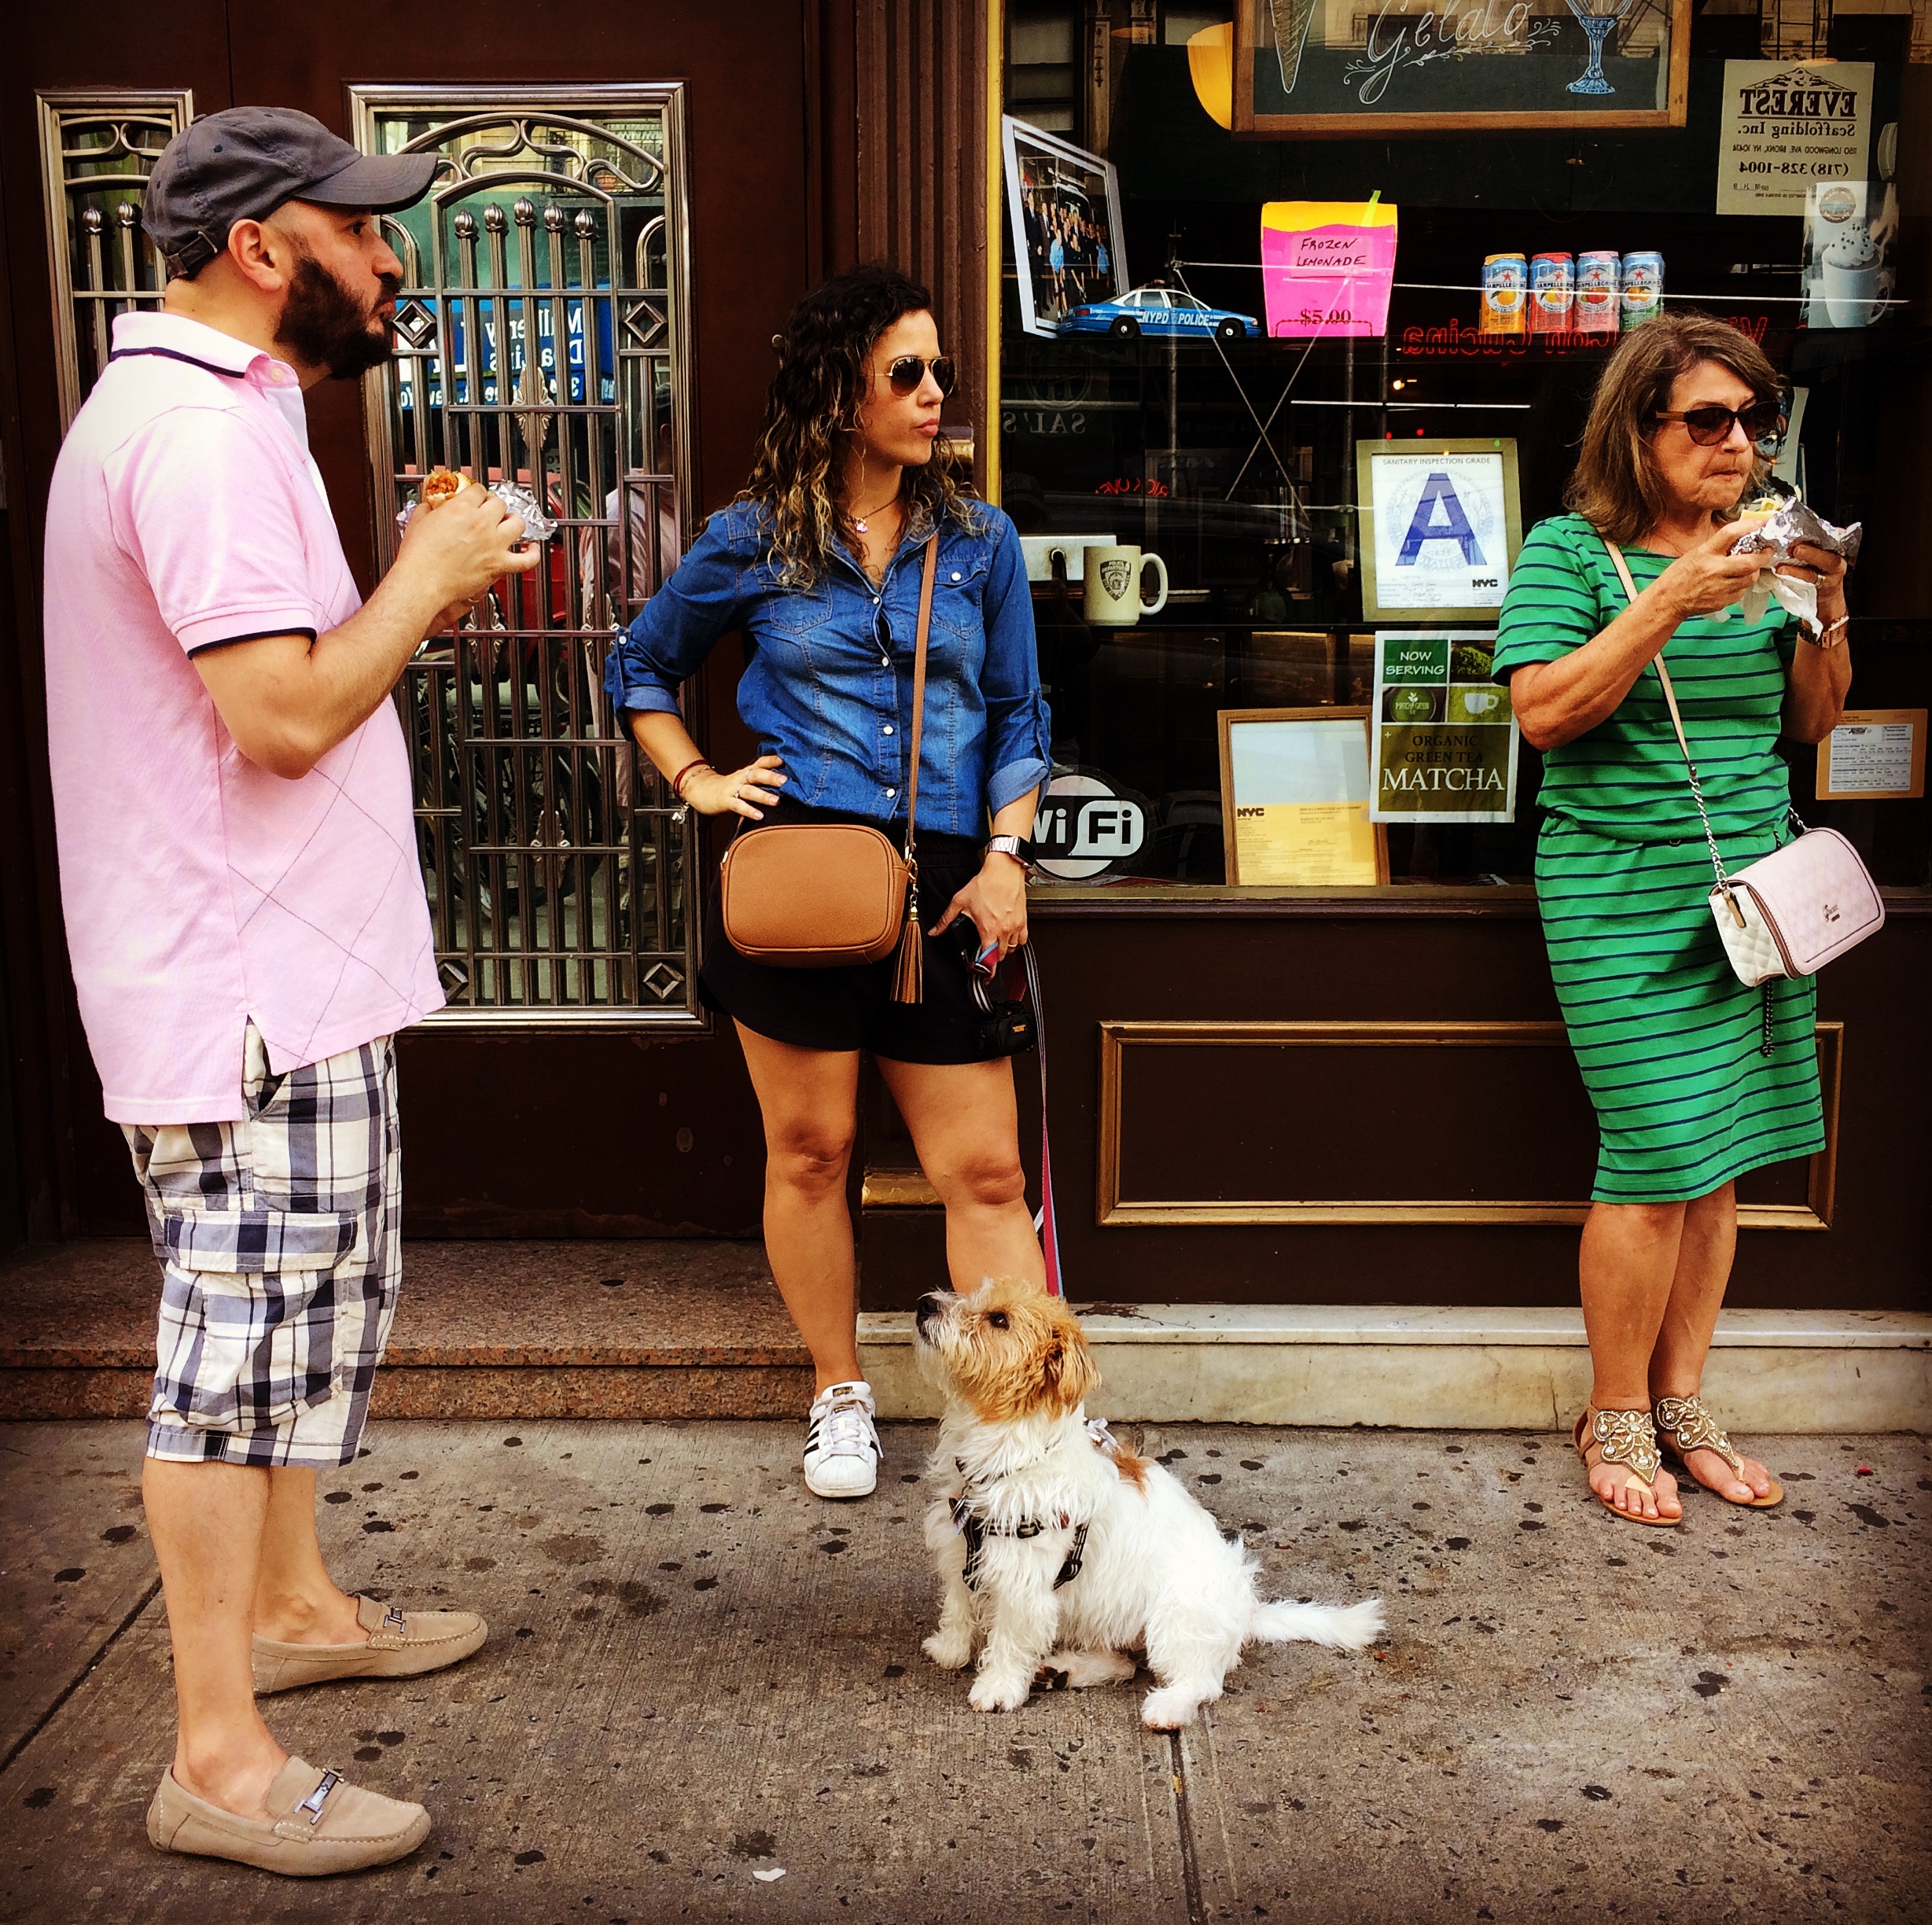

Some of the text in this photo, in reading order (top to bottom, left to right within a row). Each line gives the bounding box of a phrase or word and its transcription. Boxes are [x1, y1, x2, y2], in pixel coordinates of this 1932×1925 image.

[1301, 237, 1359, 251] FROZEN
[1297, 256, 1367, 267] LEMONADE
[1142, 311, 1211, 326] NYPD POLICE
[1300, 308, 1352, 326] $5.00
[1395, 473, 1488, 566] A
[1472, 579, 1499, 587] NYC
[1400, 651, 1433, 661] NOW
[1386, 665, 1445, 675] SERVING
[1412, 735, 1478, 747] ORGANIC
[1404, 752, 1484, 763] GREEN TEA
[1382, 768, 1506, 791] MATCHA
[1237, 808, 1264, 817] NYC
[1088, 809, 1132, 845] Fi
